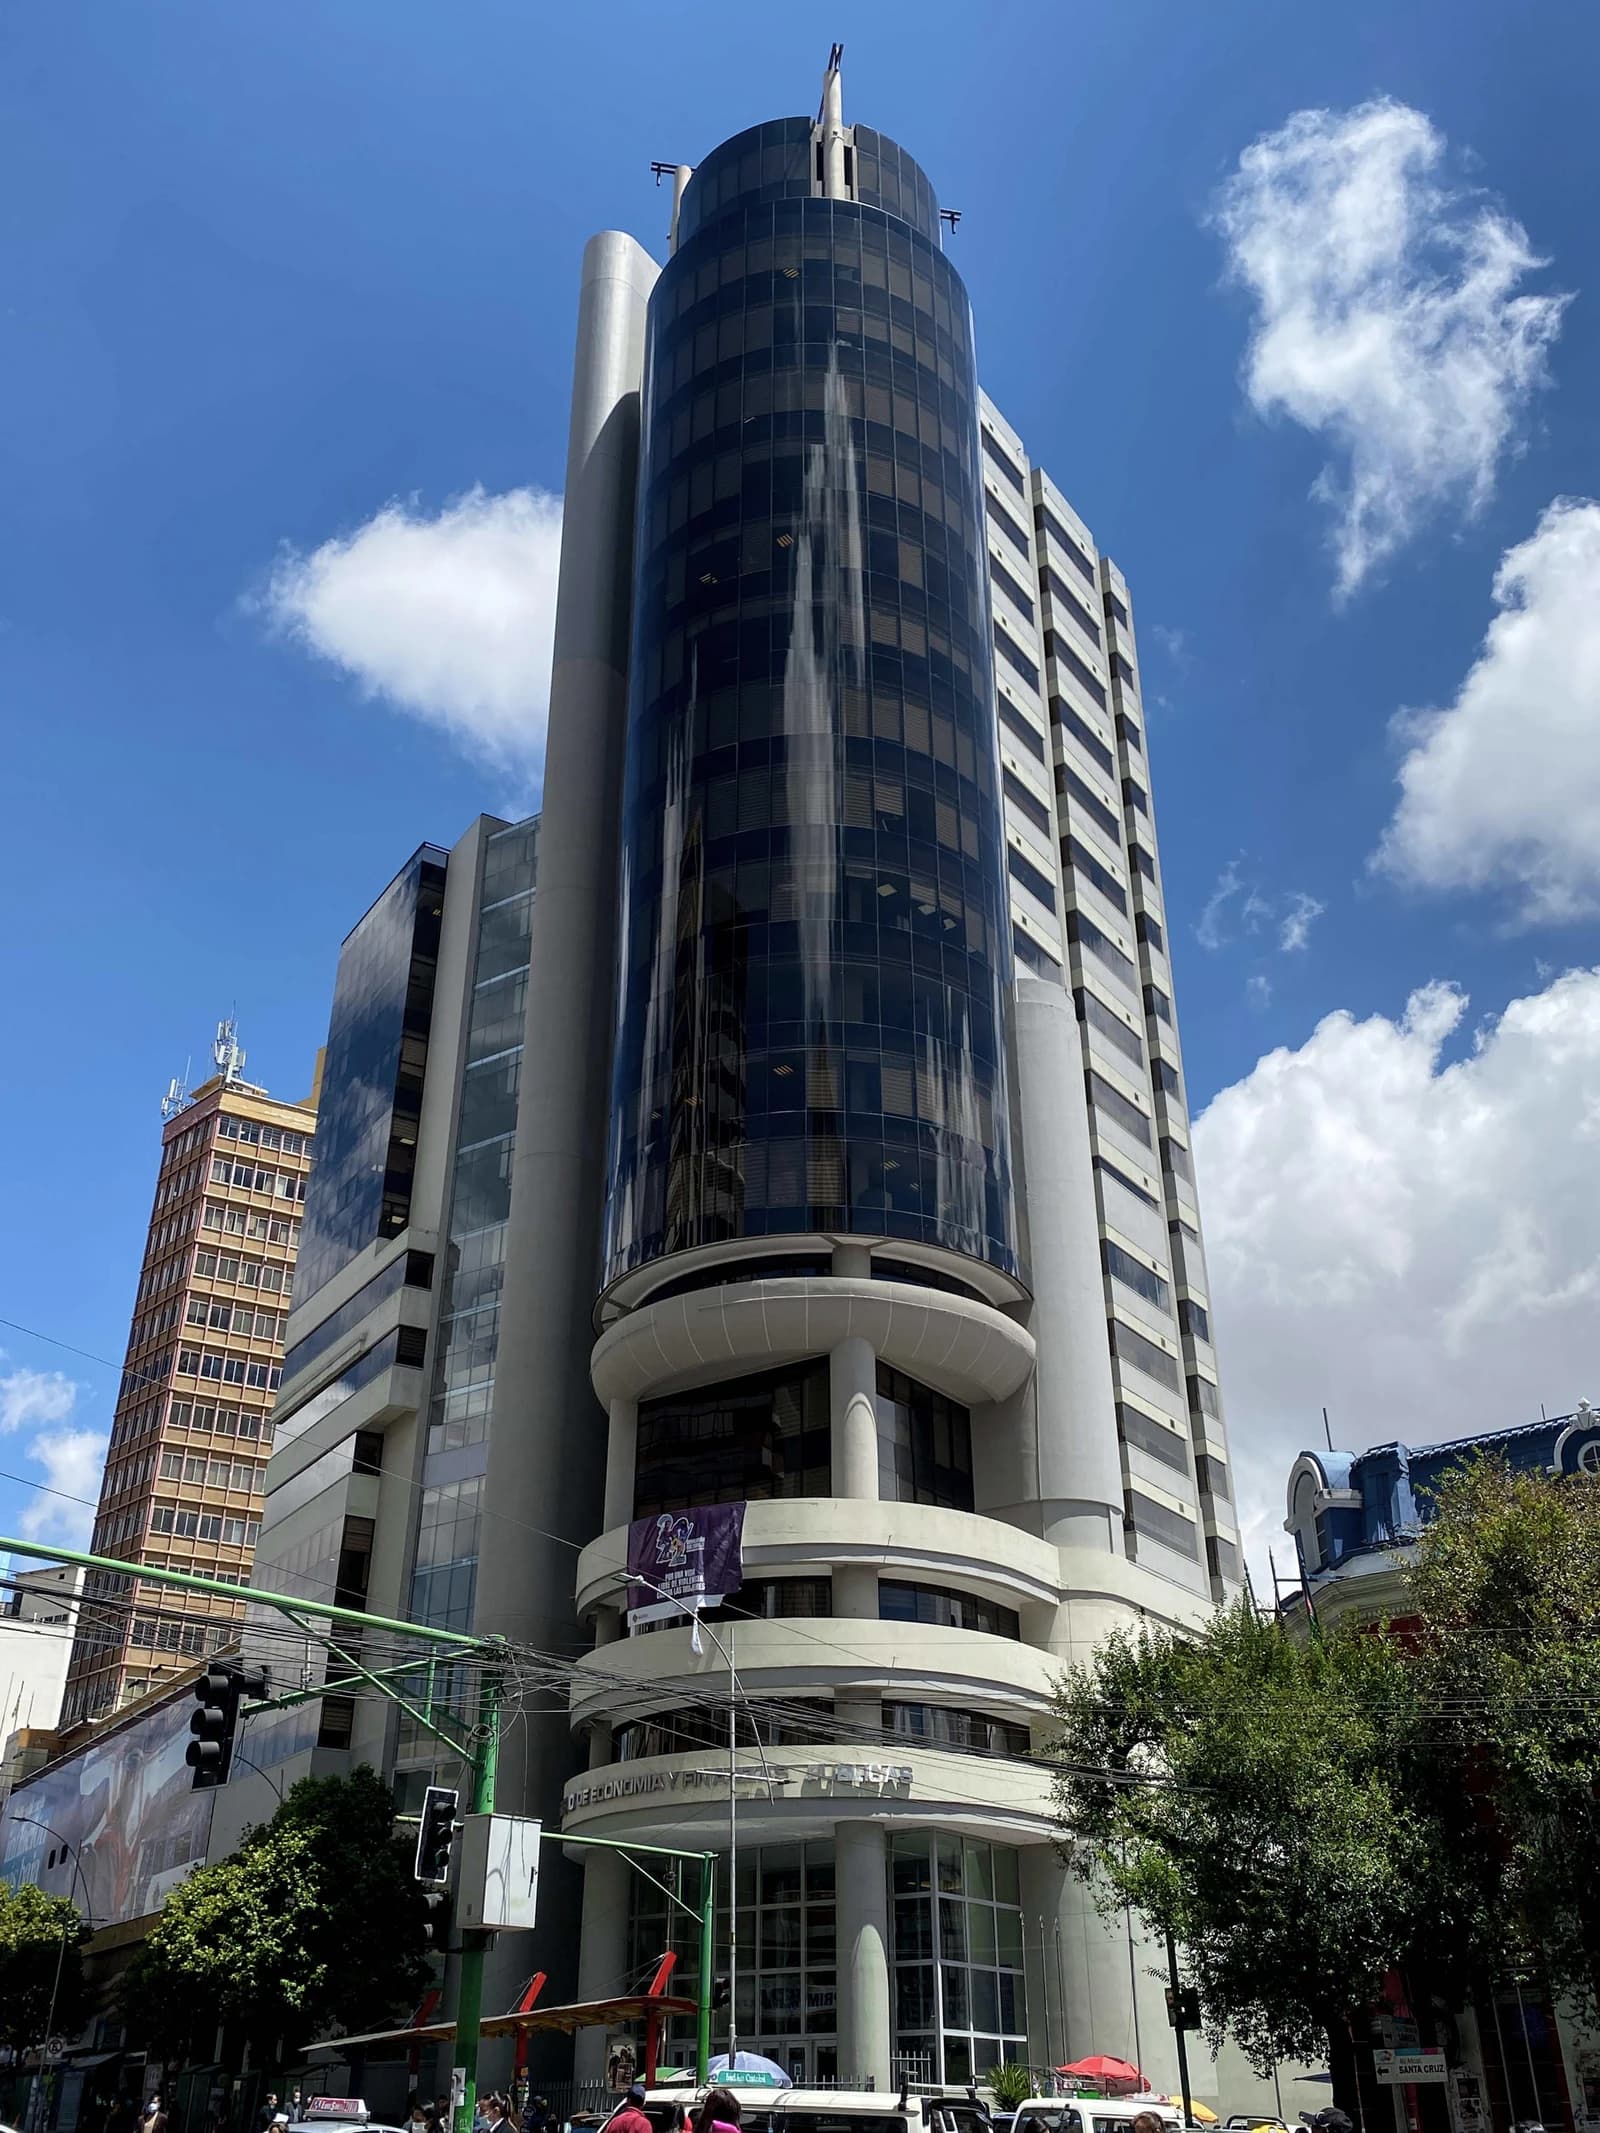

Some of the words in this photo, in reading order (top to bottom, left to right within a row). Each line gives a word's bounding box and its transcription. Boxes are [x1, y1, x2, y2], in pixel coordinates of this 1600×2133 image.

[577, 1788, 590, 1806] DE
[1399, 2065, 1423, 2074] SANTA
[1424, 2064, 1446, 2073] CRUZ
